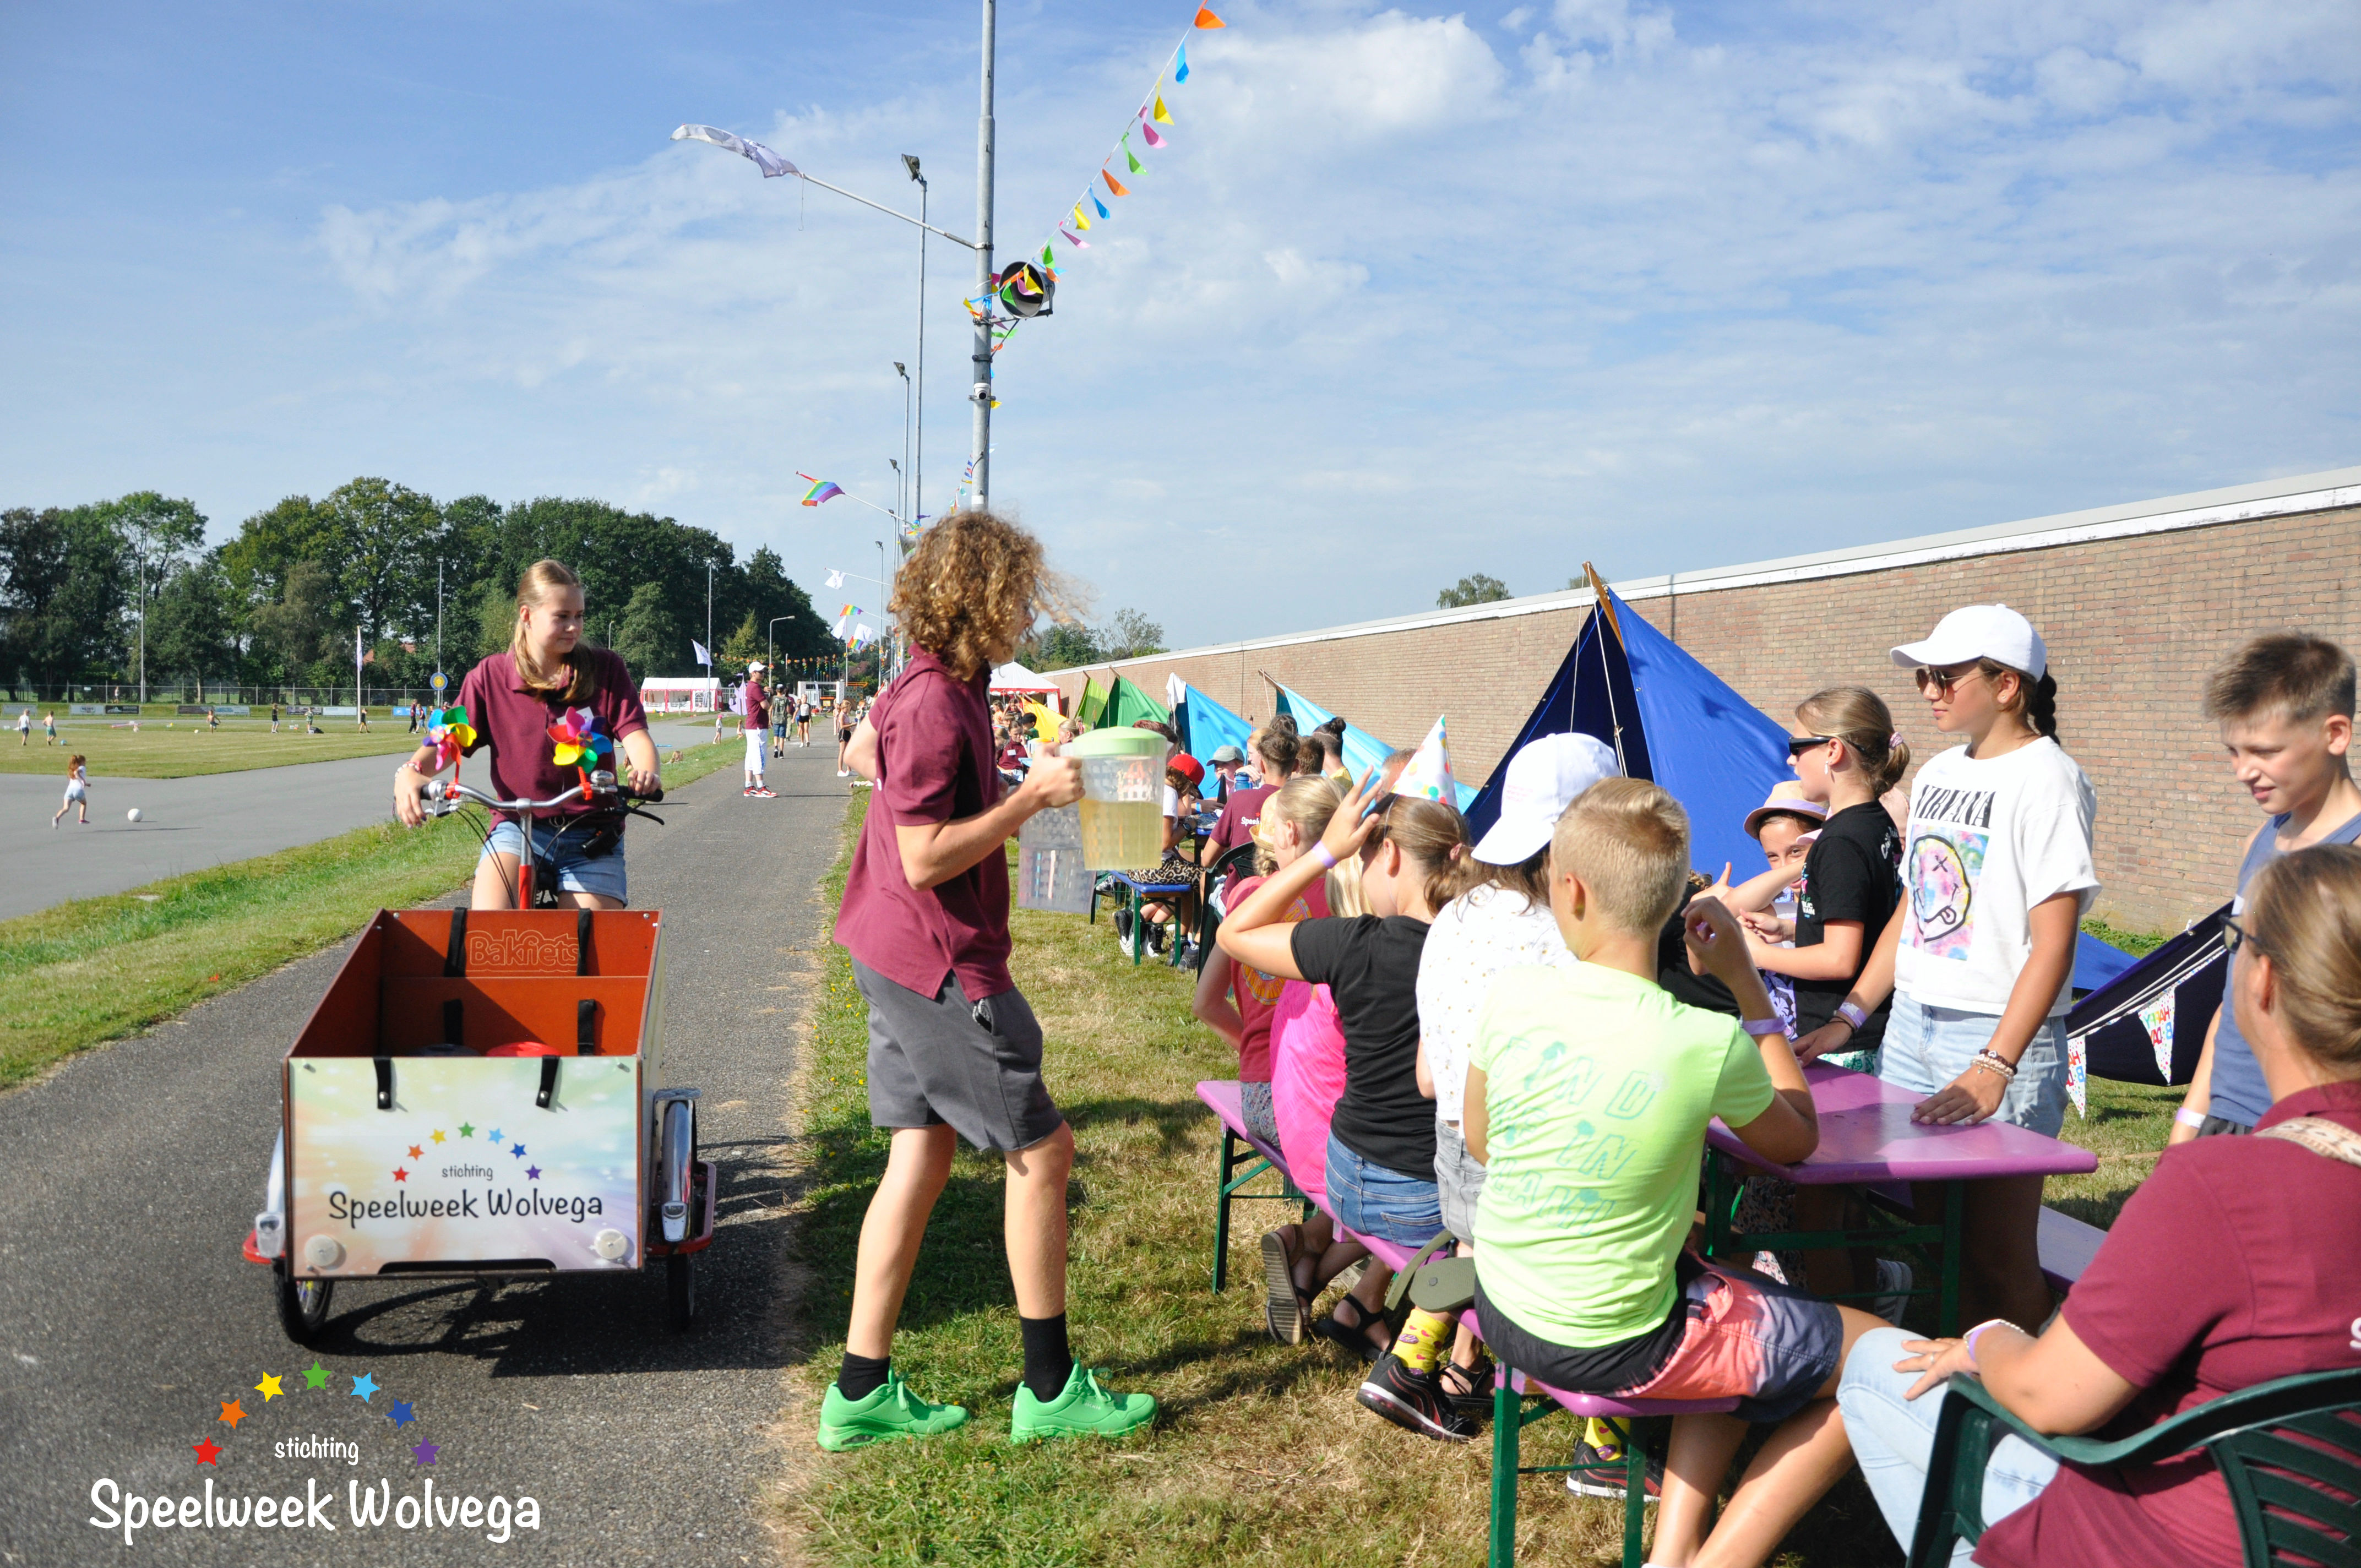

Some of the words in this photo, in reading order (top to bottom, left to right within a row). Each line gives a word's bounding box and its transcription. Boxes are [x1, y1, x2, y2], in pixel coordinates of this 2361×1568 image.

[1914, 783, 1996, 829] NIRVANA
[468, 934, 579, 967] Bakfiets
[1493, 1036, 1660, 1120] FIND
[1555, 1119, 1642, 1180] IN
[442, 1163, 494, 1181] stichting
[329, 1189, 480, 1229] Speelweek
[487, 1188, 603, 1223] Wolvega
